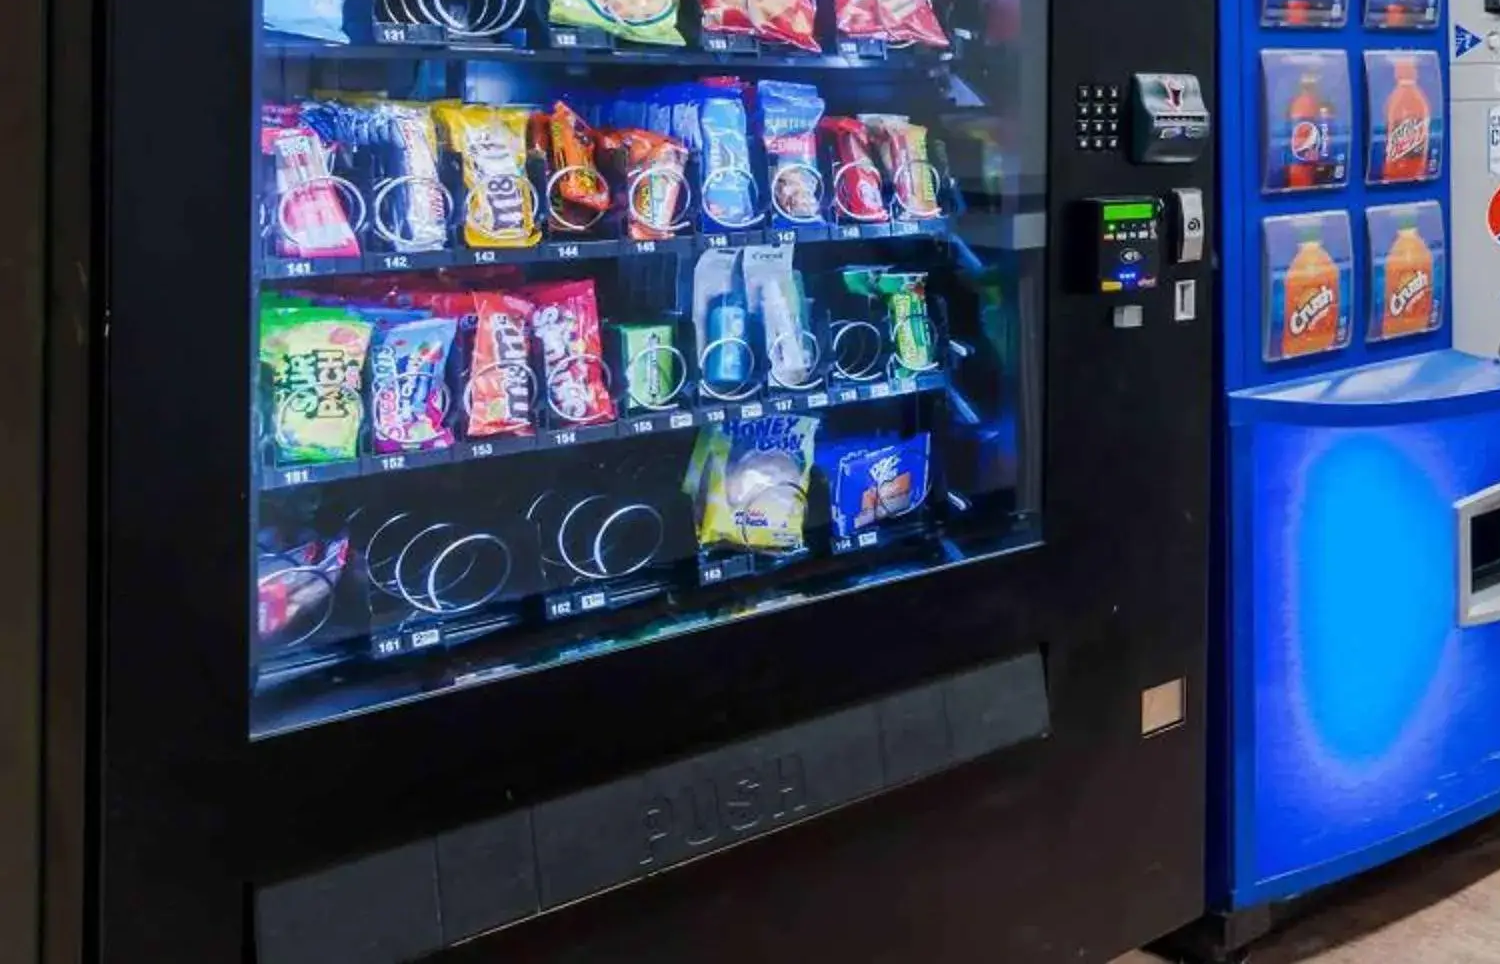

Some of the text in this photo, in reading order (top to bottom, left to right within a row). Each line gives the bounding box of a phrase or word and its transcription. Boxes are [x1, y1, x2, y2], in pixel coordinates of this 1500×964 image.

[382, 28, 406, 42] 131
[473, 251, 496, 264] 143
[557, 245, 579, 259] 144
[286, 262, 312, 276] 141
[384, 255, 408, 269] 142
[724, 415, 801, 438] HONEY
[555, 433, 577, 446] 154
[471, 443, 493, 457] 153
[550, 601, 572, 616] 162
[638, 753, 808, 865] PUSH
